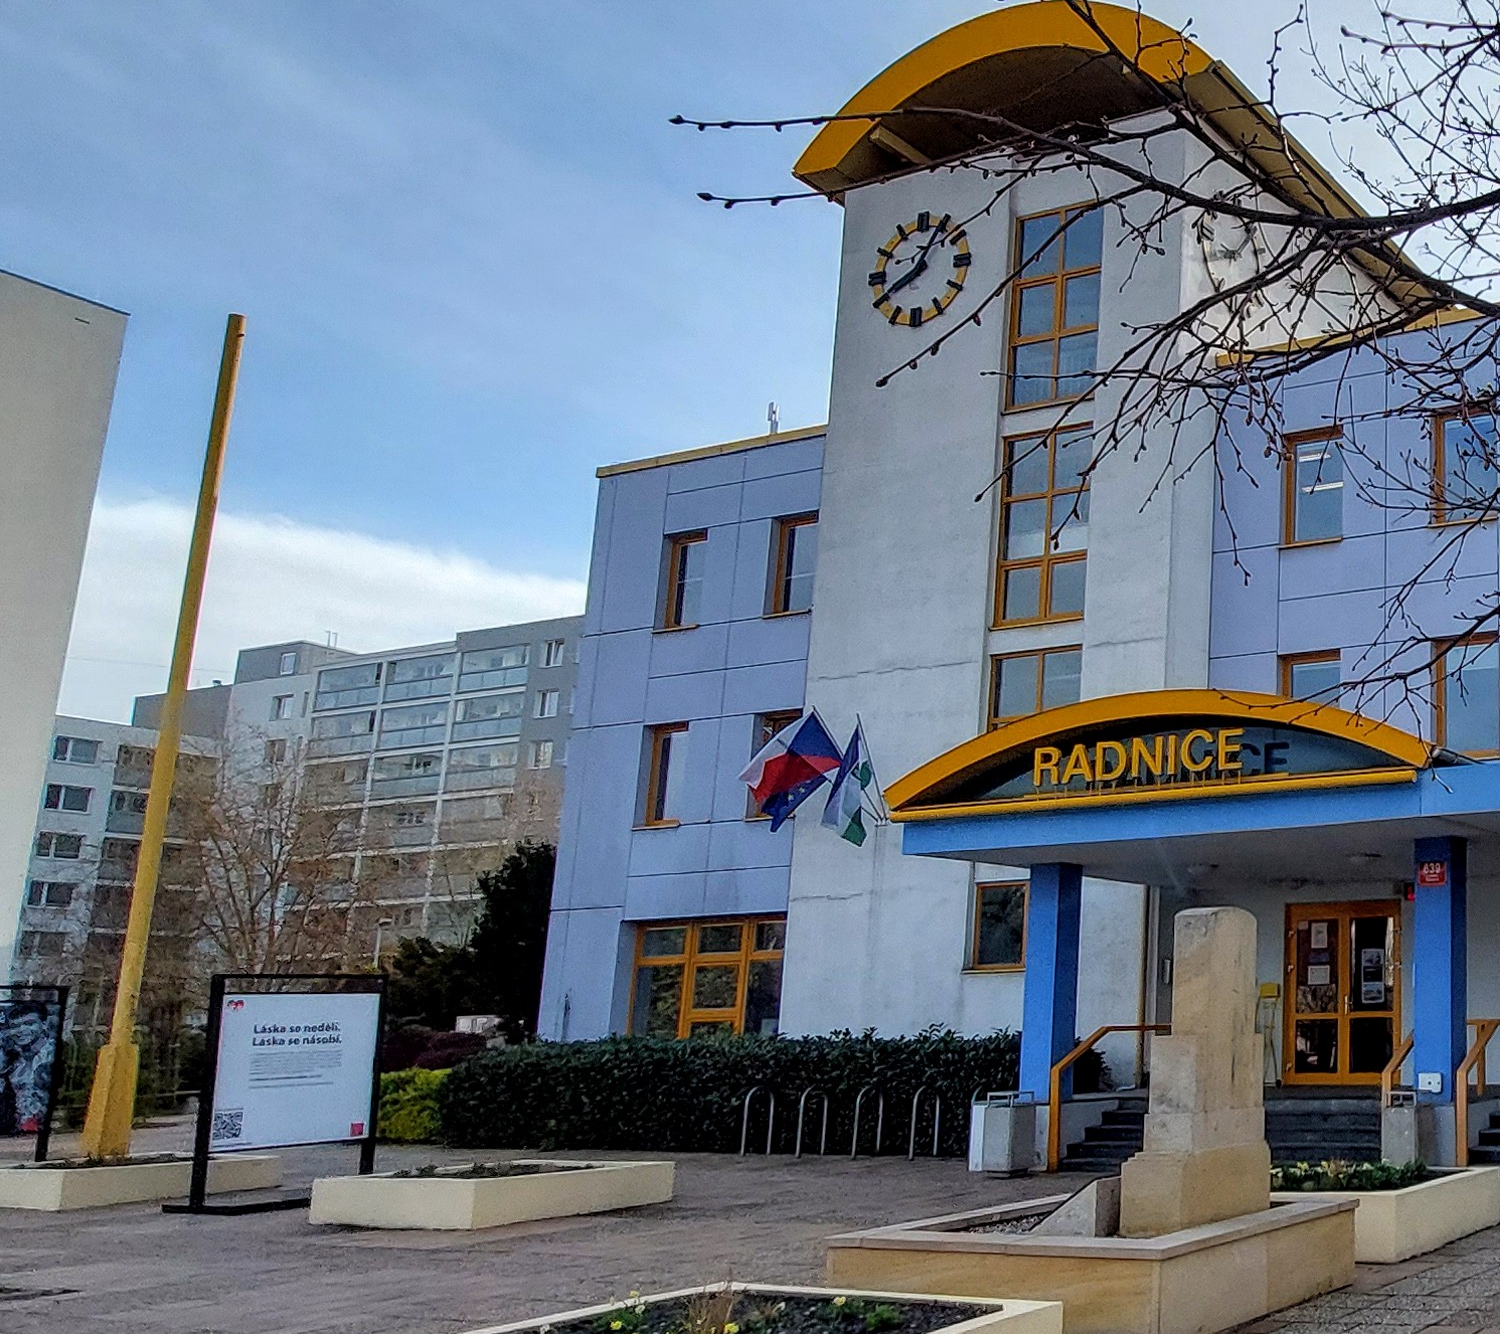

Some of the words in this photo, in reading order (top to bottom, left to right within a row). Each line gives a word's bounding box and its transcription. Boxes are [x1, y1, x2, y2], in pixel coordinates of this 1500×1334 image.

[1033, 727, 1245, 786] RADNICE
[288, 1037, 301, 1046] se
[302, 1033, 342, 1045] násobí.
